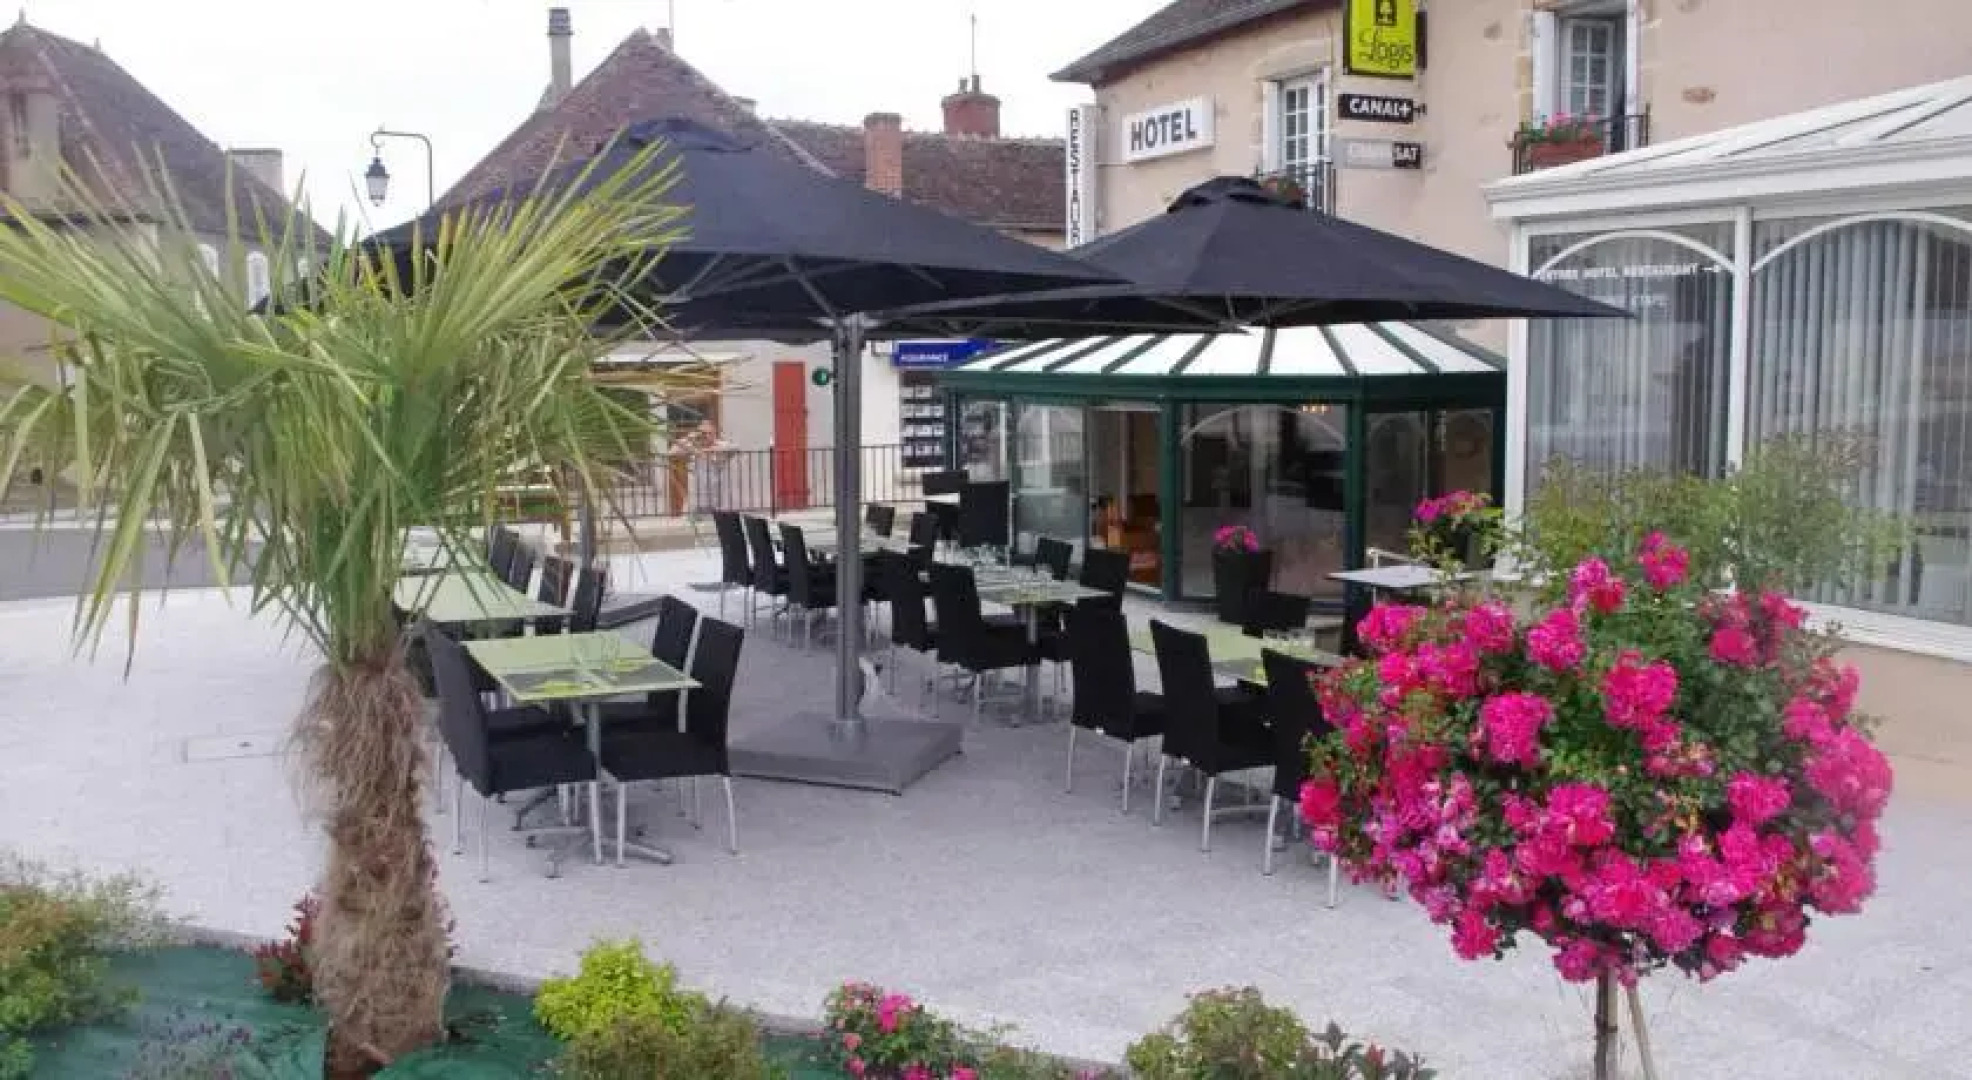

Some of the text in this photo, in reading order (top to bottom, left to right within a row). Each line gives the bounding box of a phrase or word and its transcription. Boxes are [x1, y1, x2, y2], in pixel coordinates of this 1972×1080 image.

[1358, 27, 1413, 71] Logis
[1348, 97, 1412, 117] CANAL+
[1130, 107, 1197, 151] HOTEL
[1582, 266, 1620, 279] HOTEL
[1623, 262, 1698, 278] RESTAURANT
